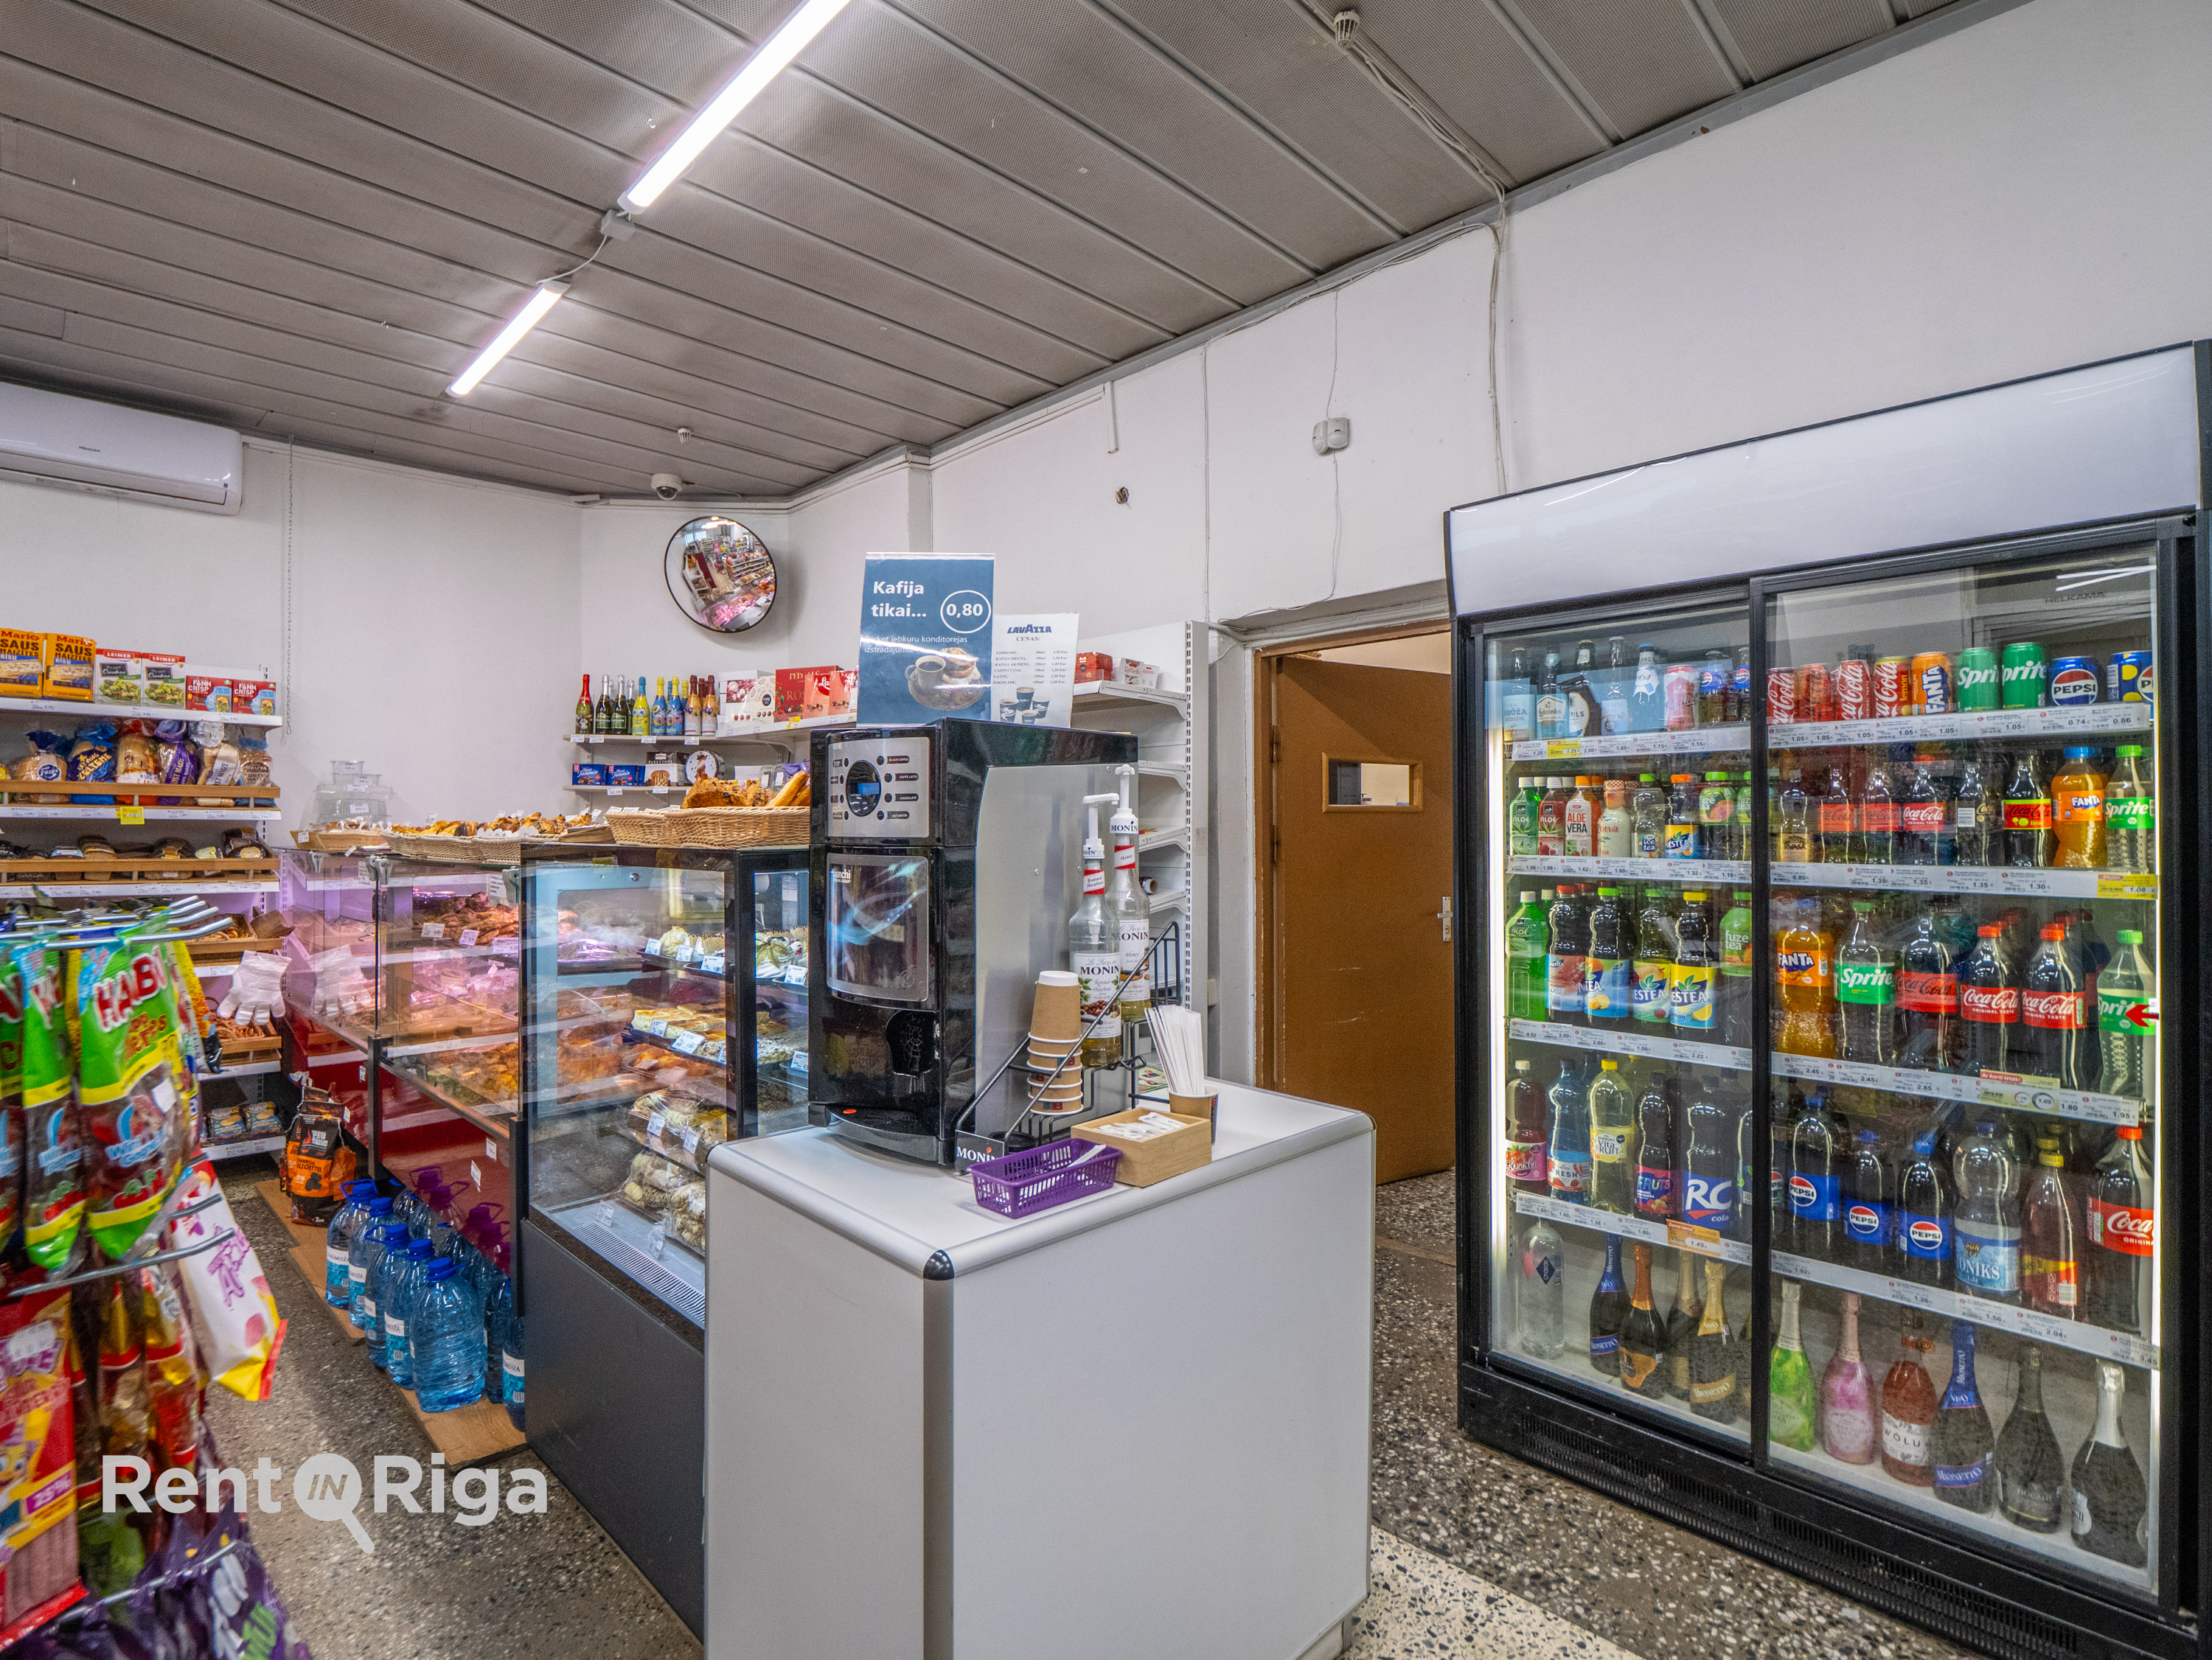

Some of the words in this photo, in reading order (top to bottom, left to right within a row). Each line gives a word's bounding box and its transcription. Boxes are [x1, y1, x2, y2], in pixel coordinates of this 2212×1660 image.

[873, 581, 925, 598] Kafija
[871, 603, 927, 618] tikai...
[946, 603, 984, 618] 0,80
[1, 630, 40, 641] Mario
[1006, 624, 1052, 634] LAVAZZA
[0, 638, 40, 651] SAUS
[921, 635, 967, 644] konditorejas
[55, 643, 92, 657] SAUS
[1900, 674, 1908, 702] lemon
[1921, 664, 1947, 715] FANTA
[2053, 683, 2096, 695] PEPSI
[2071, 795, 2101, 806] FANTA
[1903, 806, 1944, 821] Coca-Cola
[2105, 801, 2149, 818] Sprite
[1567, 812, 1587, 823] ALOE
[1567, 823, 1587, 834] VERA
[1119, 932, 1148, 941] ONIN
[1725, 930, 1749, 943] fuze
[1725, 941, 1742, 951] tea
[1778, 952, 1815, 966] FANTA
[1080, 966, 1119, 975] MONIN
[1840, 968, 1893, 988] Sprite
[1634, 989, 1668, 1000] ESTEA
[1672, 991, 1710, 1003] ESTEA
[1964, 988, 2018, 1009] Coca-Cola
[1556, 1170, 1578, 1178] RESH
[1685, 1179, 1733, 1210] RC
[1790, 1185, 1815, 1198] PEPSI
[1851, 1214, 1877, 1225] PEPSI
[1912, 1230, 1941, 1241] PEPSI
[1958, 1256, 2000, 1280] ONIKS
